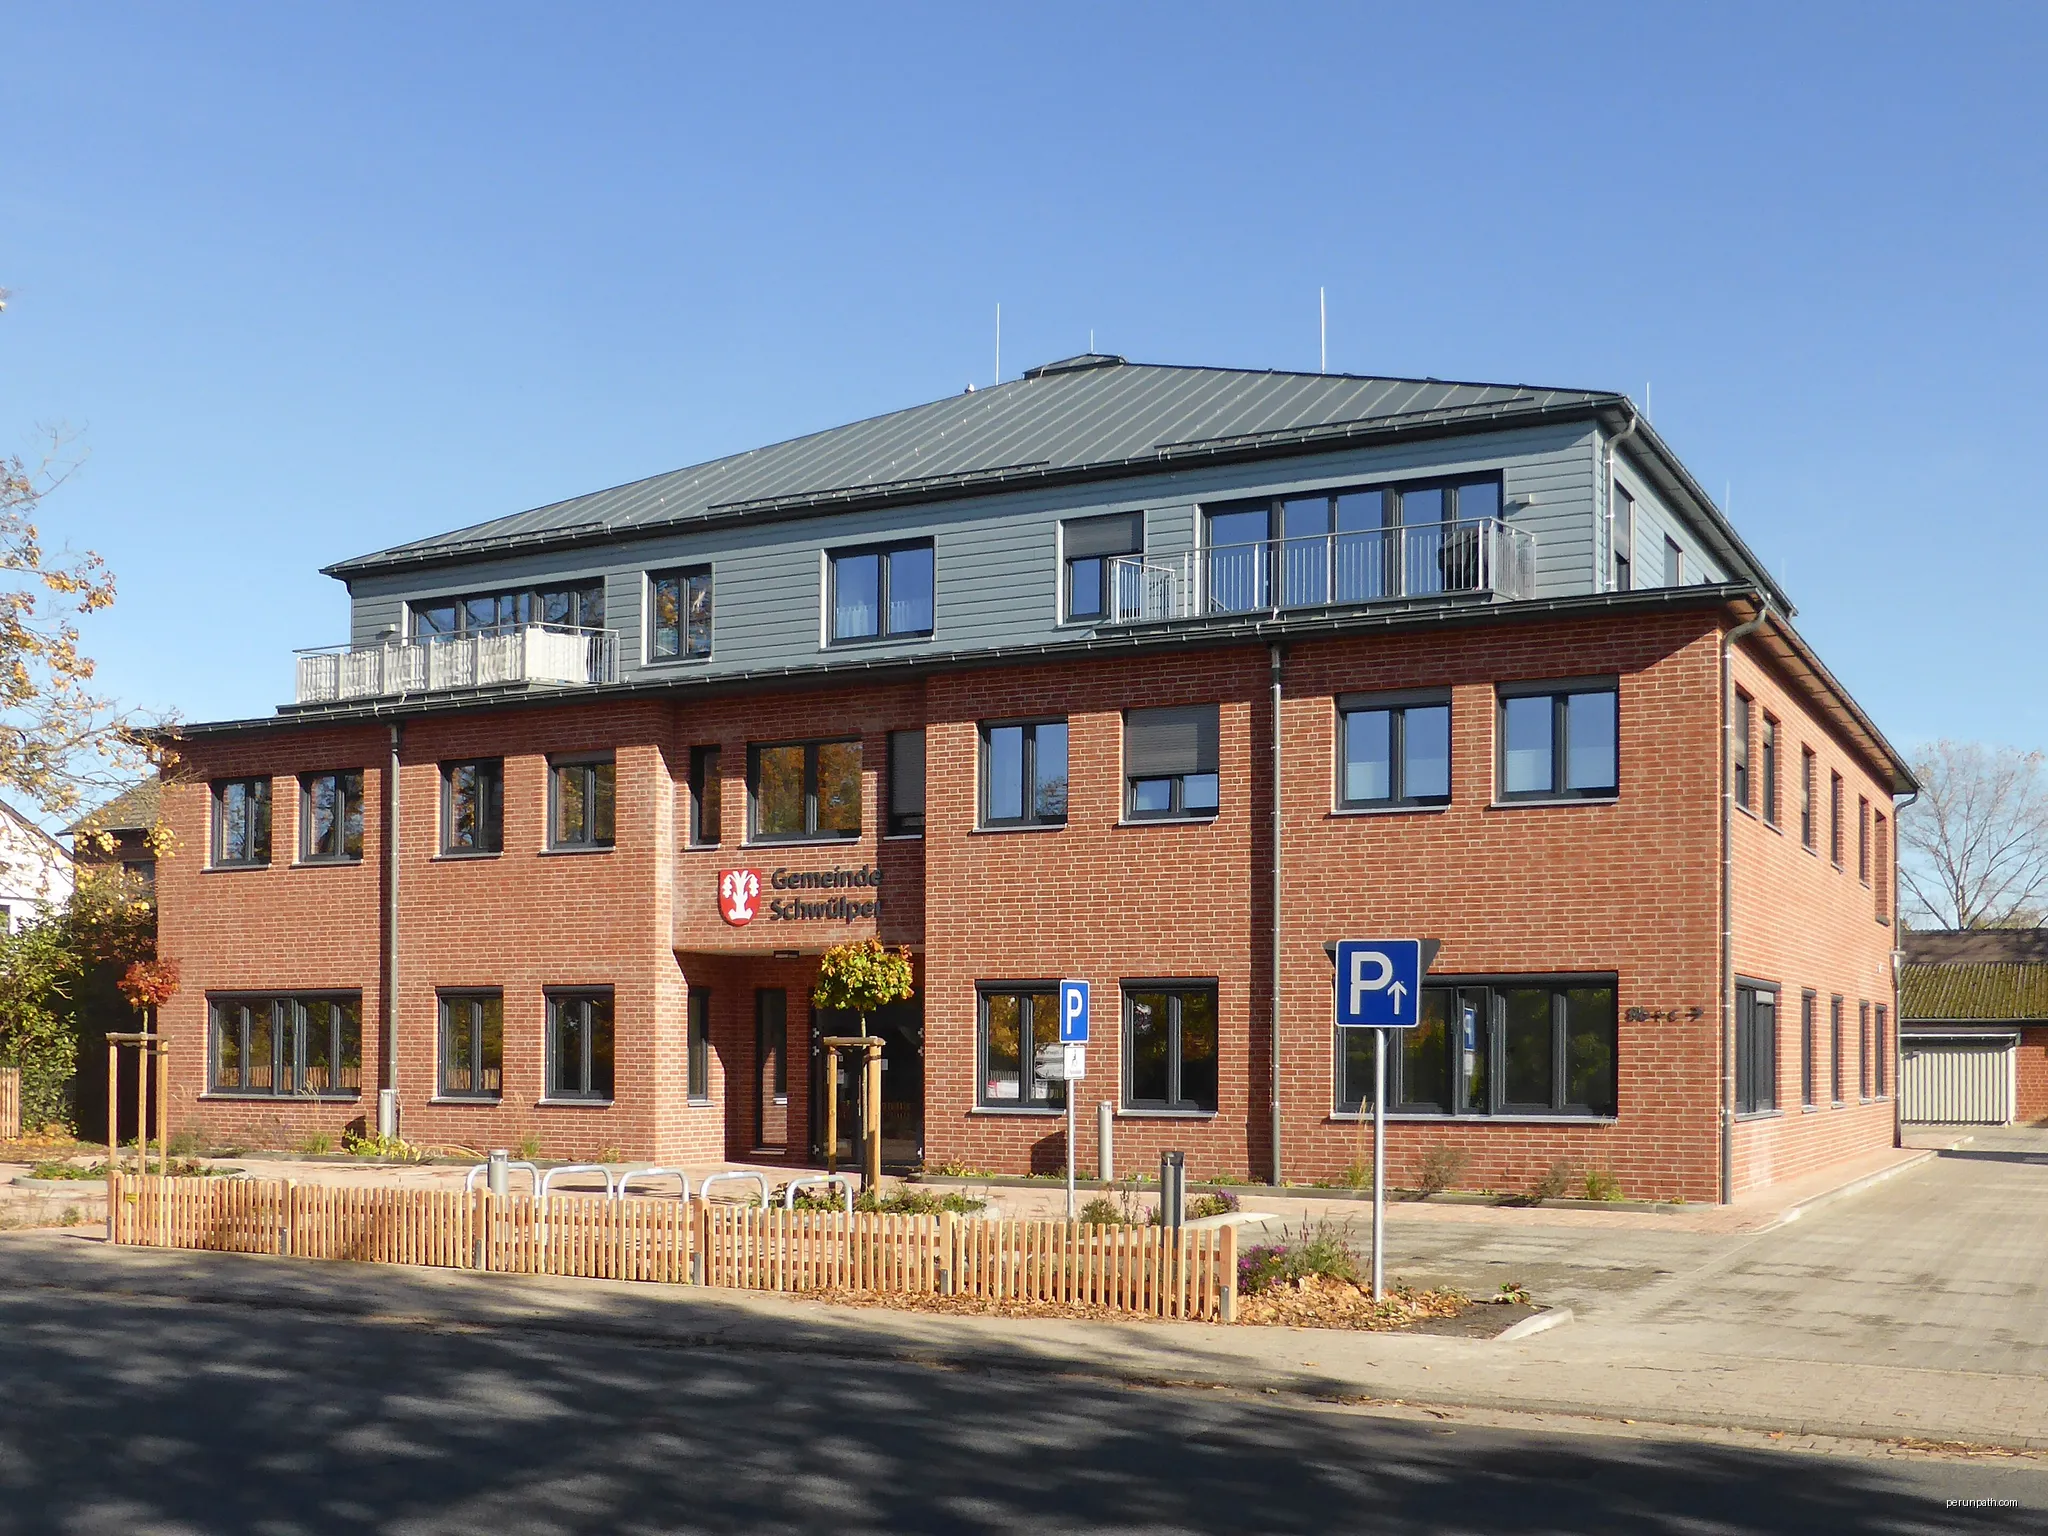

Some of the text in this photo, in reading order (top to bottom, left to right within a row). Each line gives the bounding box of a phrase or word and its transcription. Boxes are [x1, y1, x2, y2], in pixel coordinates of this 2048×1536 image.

[771, 864, 883, 889] Gemeinde
[1350, 951, 1393, 1015] P
[1066, 988, 1083, 1035] P
